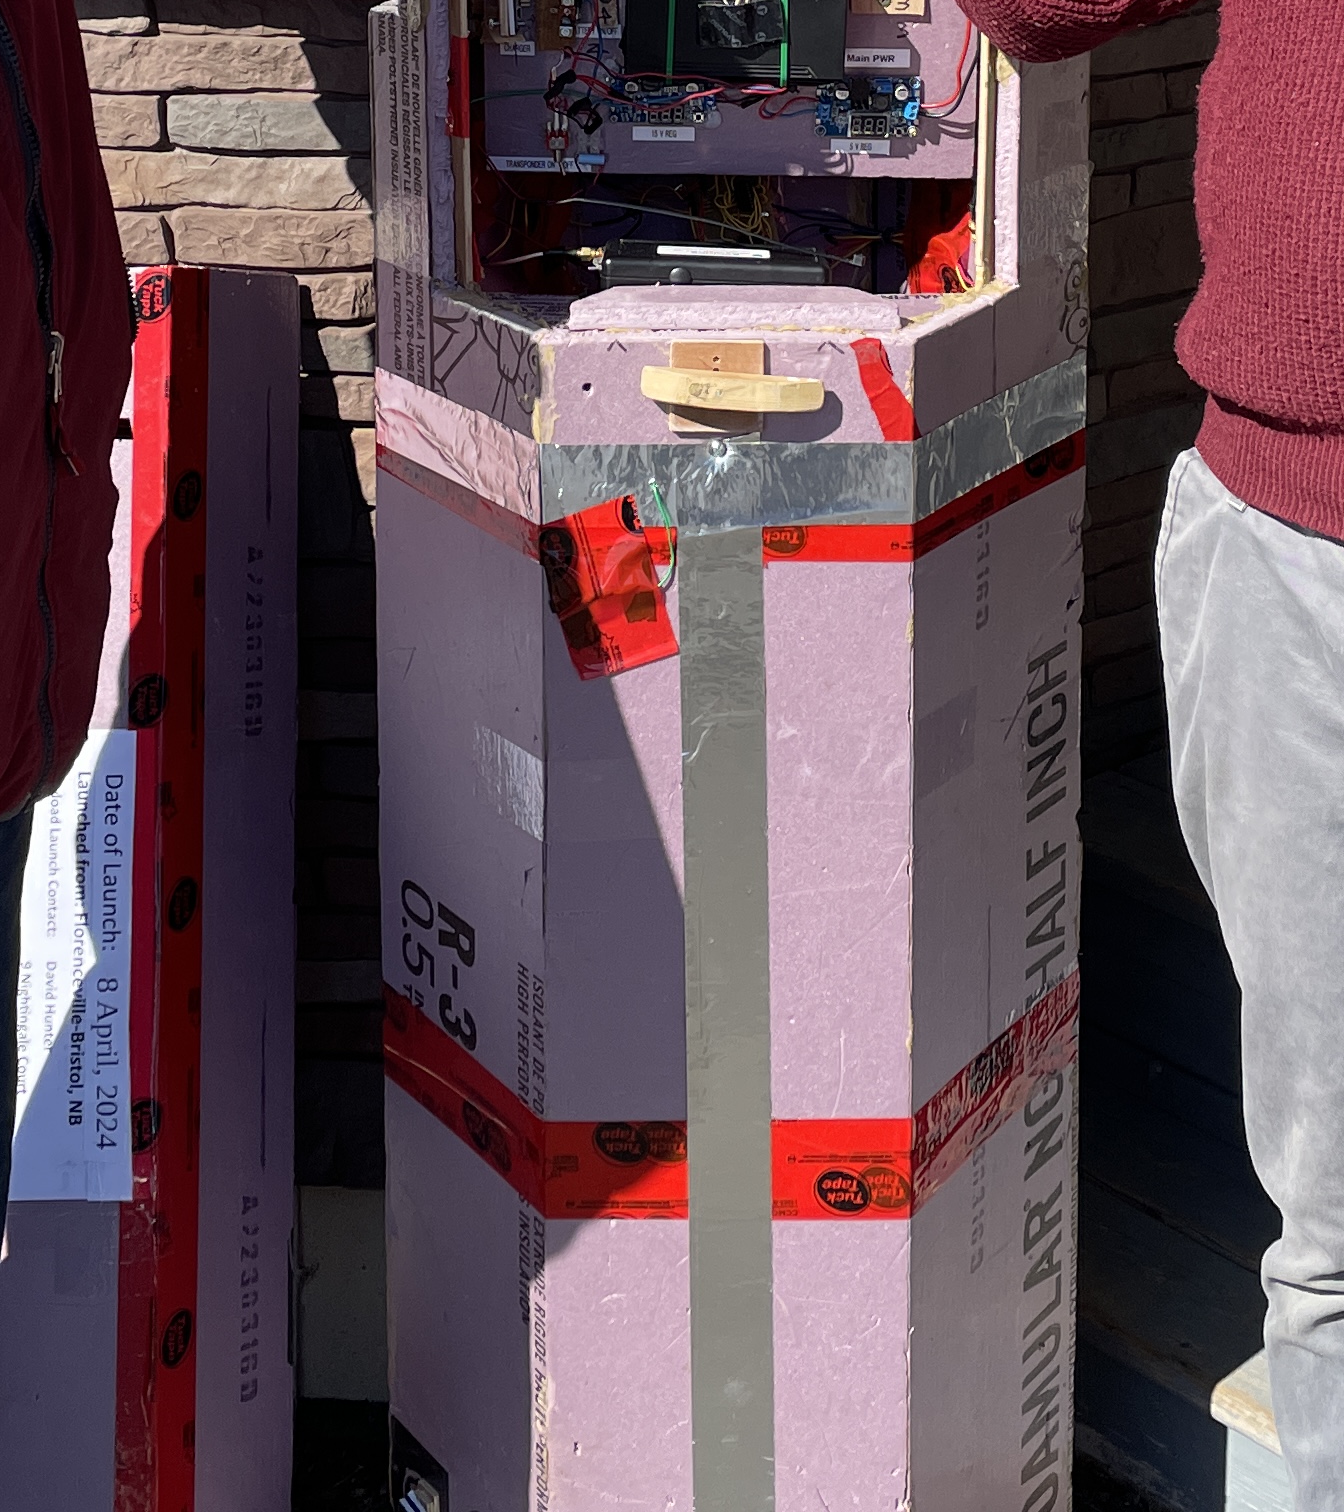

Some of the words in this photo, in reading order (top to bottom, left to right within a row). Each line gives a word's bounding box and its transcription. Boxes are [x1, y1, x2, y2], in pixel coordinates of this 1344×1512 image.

[411, 72, 420, 90] DE
[846, 54, 870, 63] Main
[873, 54, 896, 63] PWR
[411, 91, 421, 154] NOUVELLE
[665, 129, 678, 139] REG
[505, 160, 547, 170] TRANSPONDER
[140, 283, 153, 317] Tape
[151, 278, 166, 314] Tuck
[393, 267, 401, 288] ALL
[406, 272, 414, 296] AUX
[393, 291, 402, 342] FEDERAL
[406, 299, 416, 370] ÉTATS-UNIS
[394, 343, 402, 370] AND
[763, 528, 800, 544] Tuck
[50, 792, 62, 824] load
[75, 771, 92, 853] Launched
[103, 774, 124, 826] Date
[47, 828, 61, 877] Launch
[103, 833, 123, 857] of
[74, 859, 91, 906] from:
[46, 880, 60, 938] Contact:
[102, 863, 122, 951] Launch:
[1025, 841, 1067, 1009] HALF
[401, 879, 435, 988] 0.5
[19, 961, 32, 970] 9
[44, 961, 57, 1000] David
[96, 978, 118, 993] 8
[437, 902, 477, 1052] R-3
[517, 962, 530, 1015] HIGH
[17, 974, 32, 1056] Nightingale
[66, 912, 88, 1095] Florenceville-Bristol,
[532, 974, 545, 1056] ISOLANT
[43, 1004, 57, 1054] Hunter
[90, 1001, 119, 1076] April,
[17, 1056, 30, 1095] Court
[517, 1018, 530, 1105] PERFOR
[532, 1056, 545, 1084] DE
[68, 1100, 83, 1126] NB
[96, 1085, 118, 1150] 2024
[821, 1177, 859, 1192] Tape
[826, 1189, 864, 1206] Tuck
[518, 1210, 531, 1326] INSULATION
[534, 1302, 547, 1367] RIGIDE
